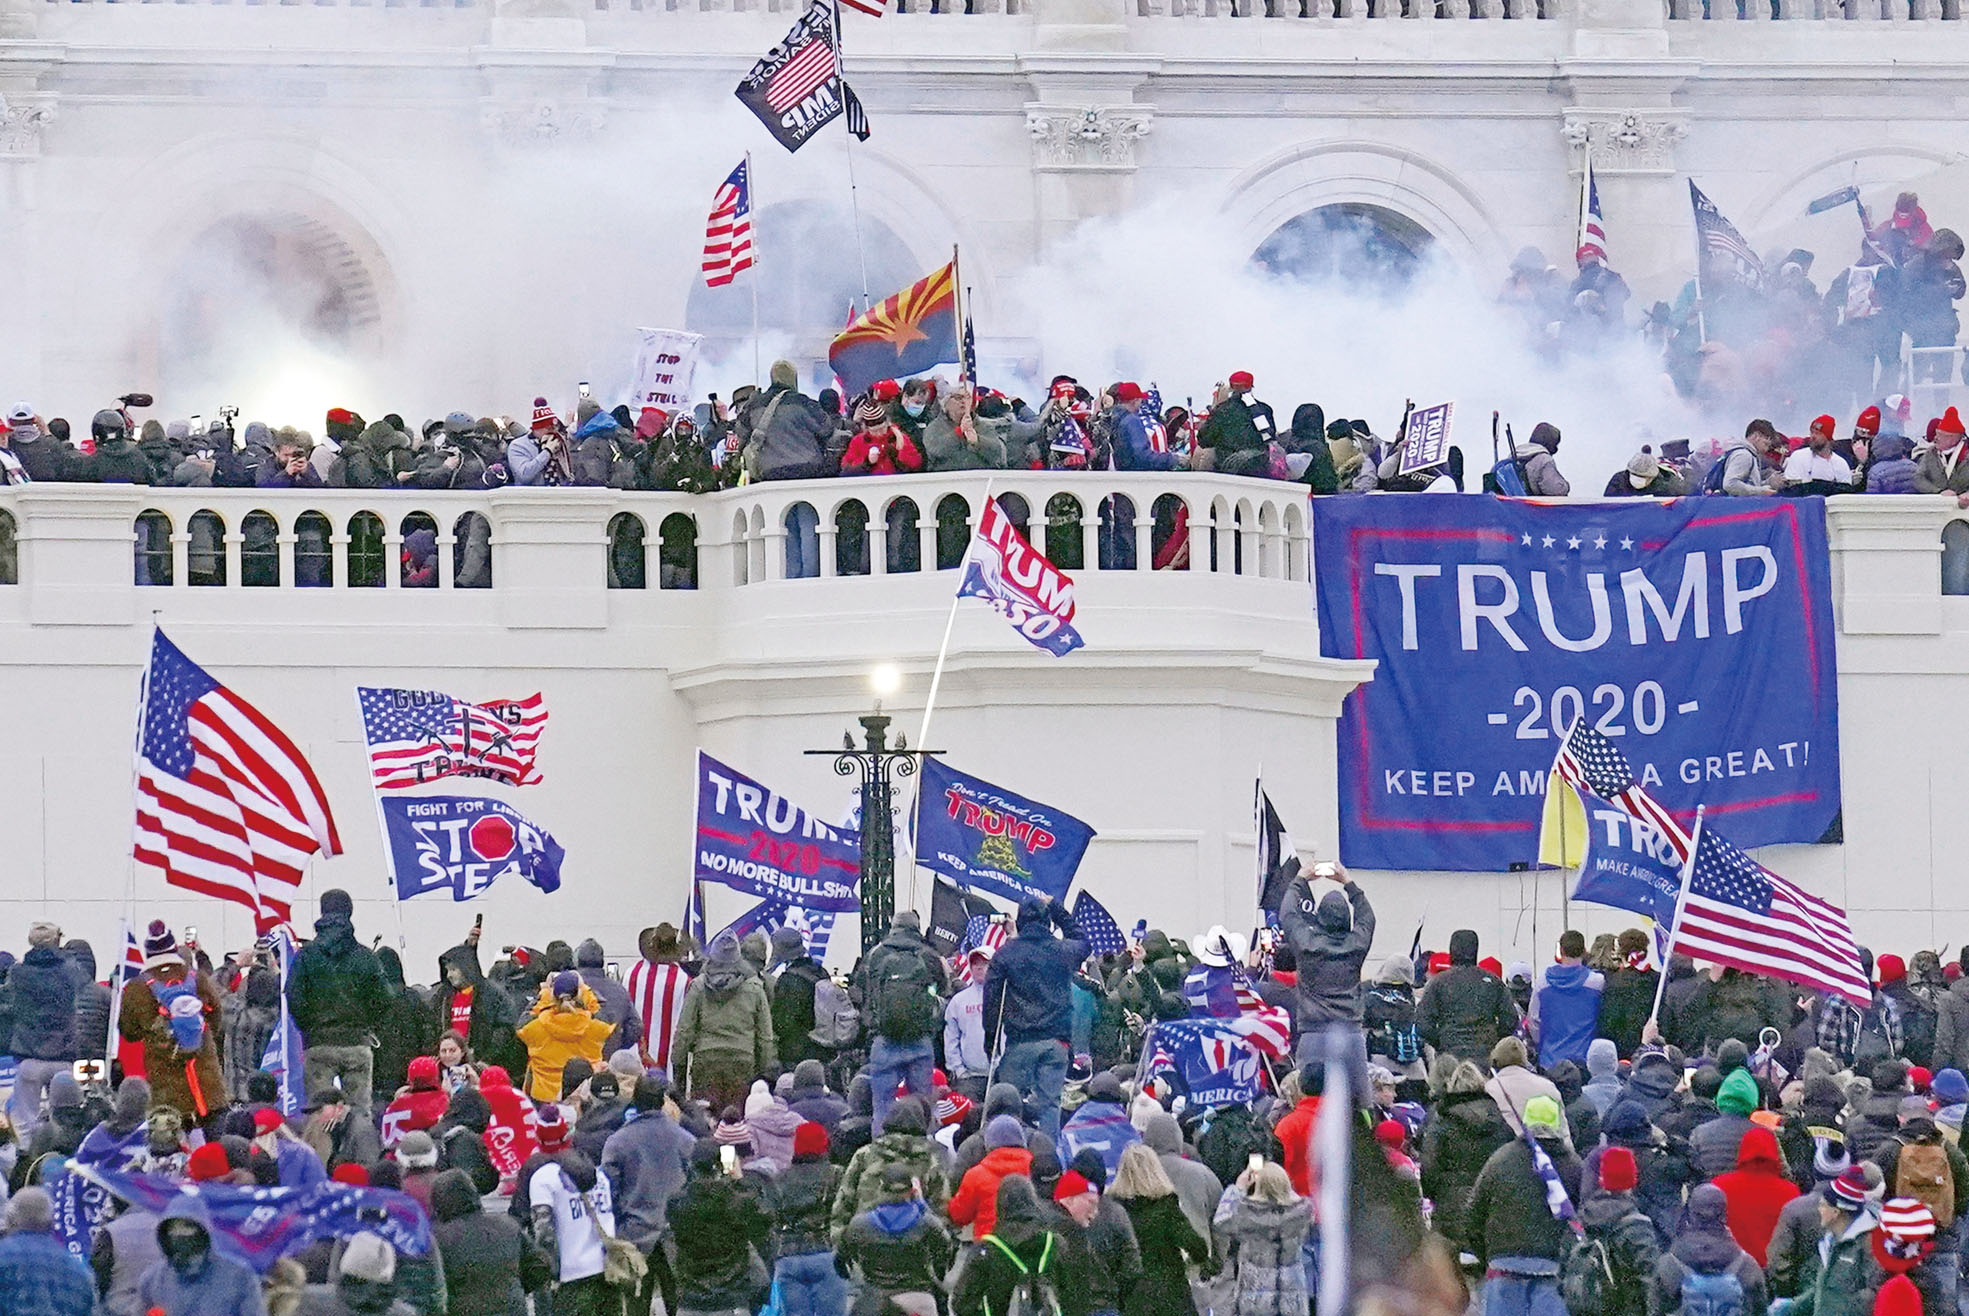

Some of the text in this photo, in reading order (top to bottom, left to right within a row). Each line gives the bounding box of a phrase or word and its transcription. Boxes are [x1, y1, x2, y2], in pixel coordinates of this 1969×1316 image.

[656, 353, 681, 365] STOP
[1407, 424, 1422, 458] 2020
[1422, 406, 1445, 462] TRUMP
[1374, 545, 1778, 652] TRUMP
[1384, 769, 1475, 796] KEEP
[1680, 741, 1810, 783] GREAT!
[407, 801, 485, 817] FIGHT FOR
[708, 771, 861, 847] TRUM
[945, 788, 1056, 856] TRUMP
[988, 795, 1032, 816] Tread
[1029, 813, 1052, 827] On
[1593, 809, 1683, 869] TRU
[701, 850, 727, 871] NO
[727, 860, 780, 886] MORE
[937, 851, 967, 871] KEEP
[969, 868, 1023, 893] AMERICA
[1596, 858, 1629, 876] MAKE
